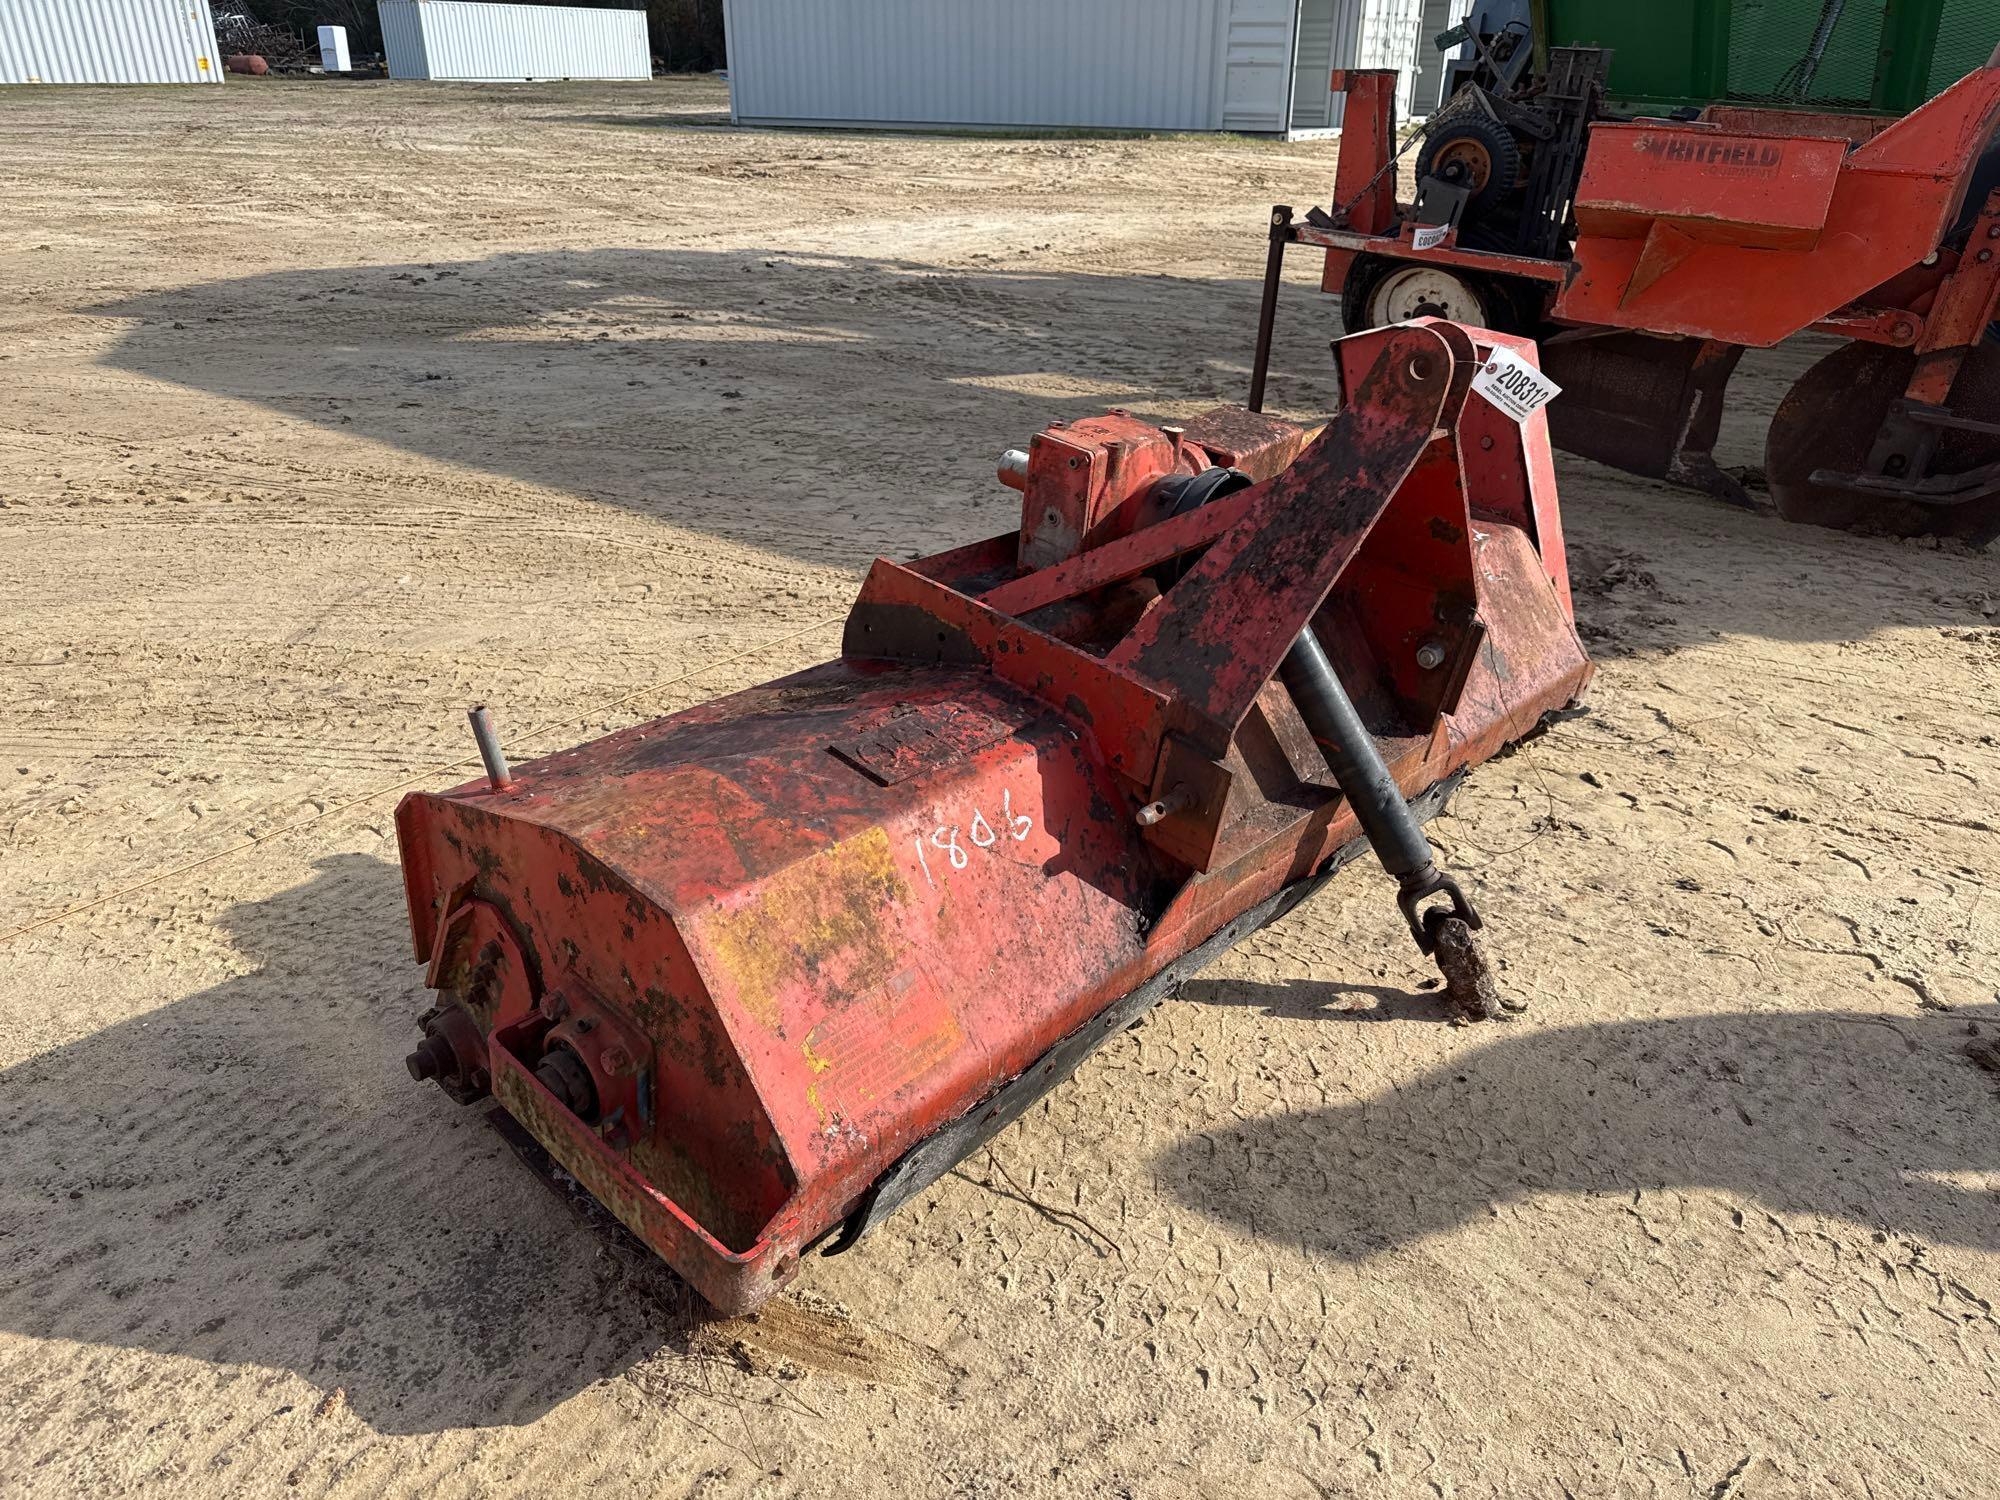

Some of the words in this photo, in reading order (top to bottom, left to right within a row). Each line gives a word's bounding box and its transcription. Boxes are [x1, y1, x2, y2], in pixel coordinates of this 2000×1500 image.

[1642, 137, 1780, 167] WHITFIELD
[1496, 363, 1550, 409] 208312
[915, 788, 1033, 891] 1806
